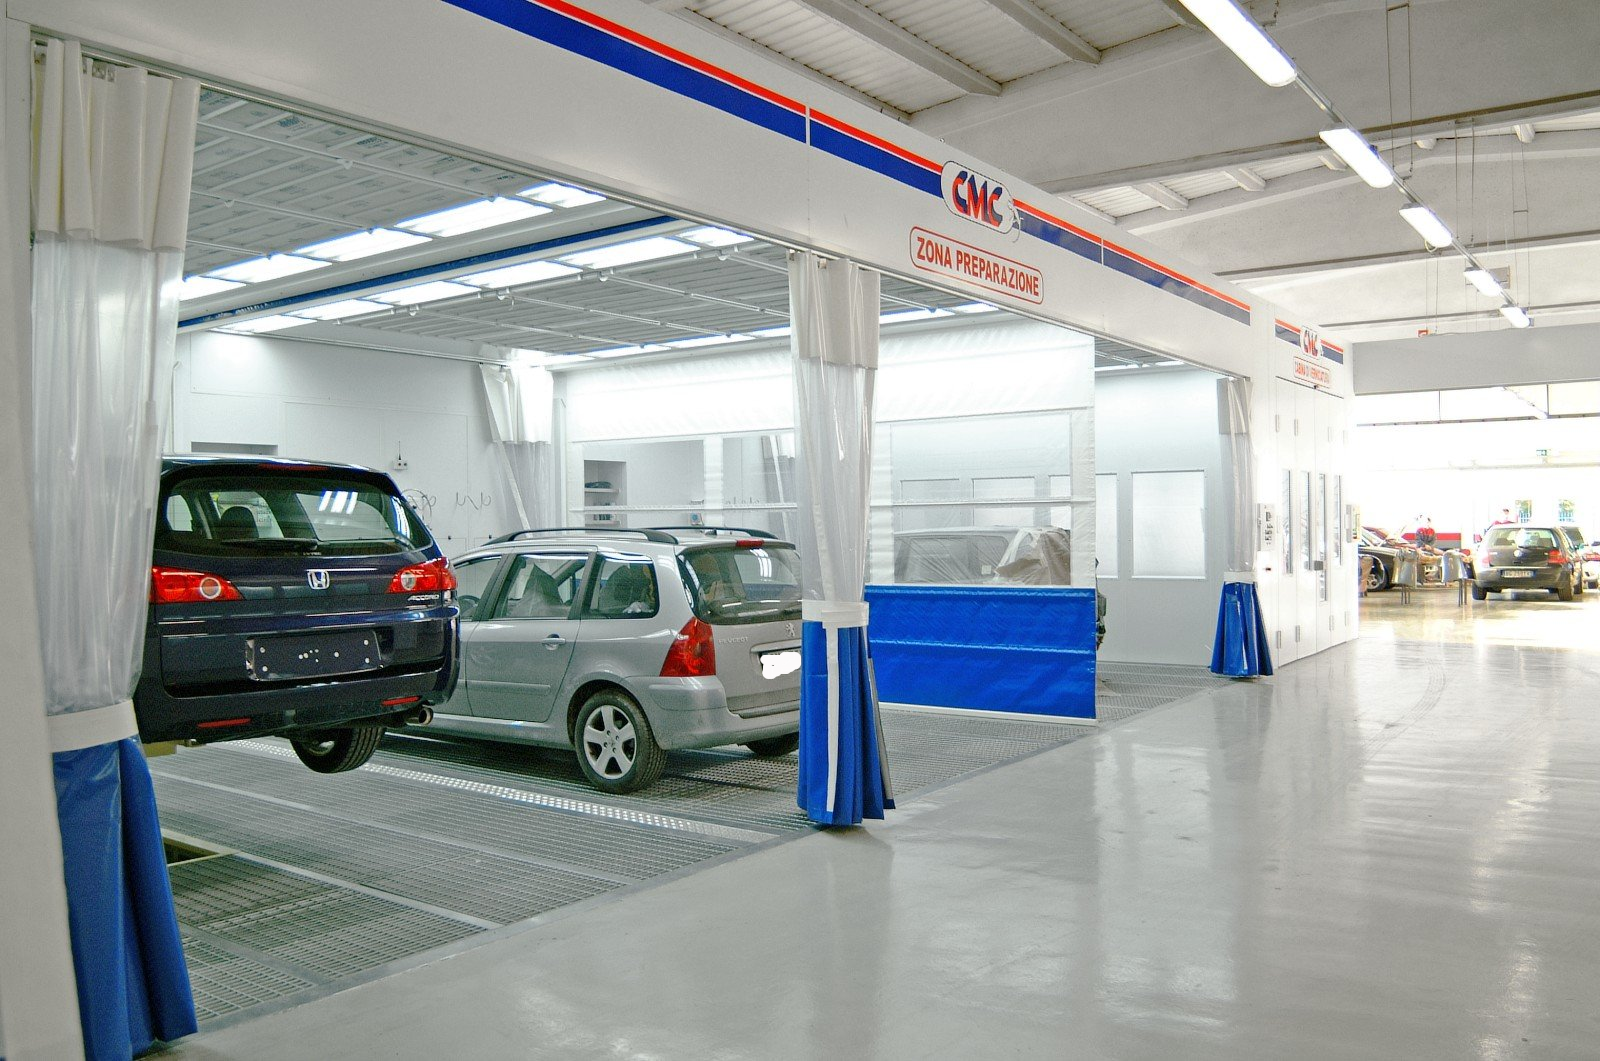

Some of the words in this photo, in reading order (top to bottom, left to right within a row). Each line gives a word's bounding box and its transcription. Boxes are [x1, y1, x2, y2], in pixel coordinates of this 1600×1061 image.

[952, 170, 1003, 228] CMC
[916, 236, 953, 270] ZONA
[956, 249, 1039, 297] PREPARAZIONE
